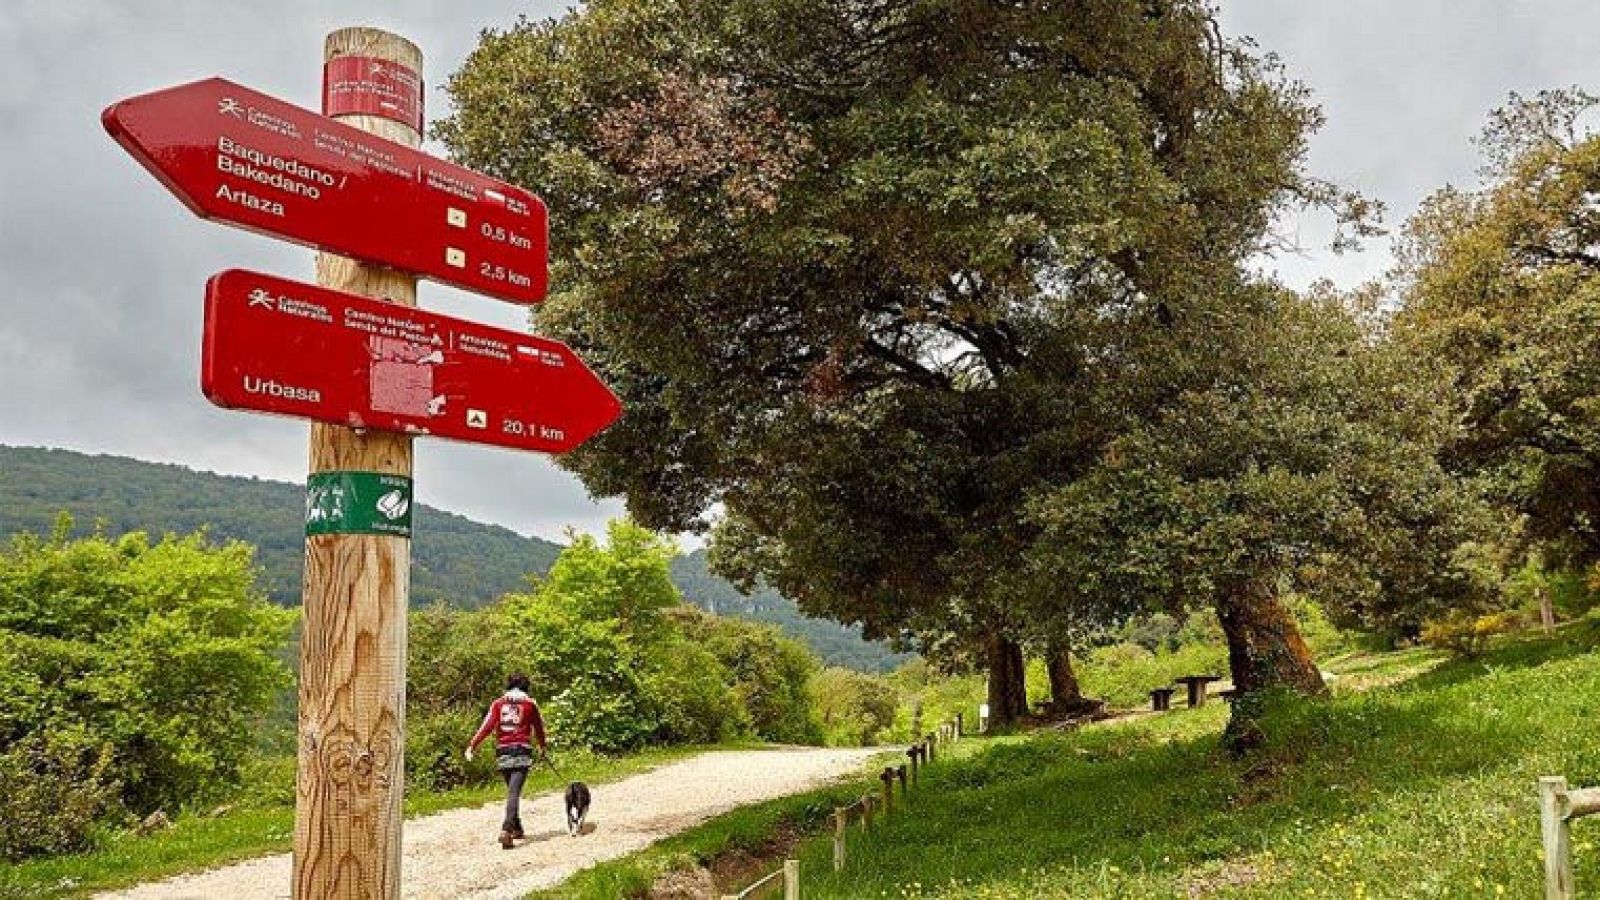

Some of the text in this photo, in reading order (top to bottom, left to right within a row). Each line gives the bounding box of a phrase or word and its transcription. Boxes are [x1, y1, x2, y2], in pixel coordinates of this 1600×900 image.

[218, 136, 347, 189] Baquedano /
[218, 154, 320, 199] Bakedano
[216, 184, 284, 217] Artaza
[481, 222, 532, 250] 0,5 km
[480, 262, 531, 287] 2,5 km
[243, 375, 320, 403] Urbasa
[503, 419, 564, 441] 20,1 km
